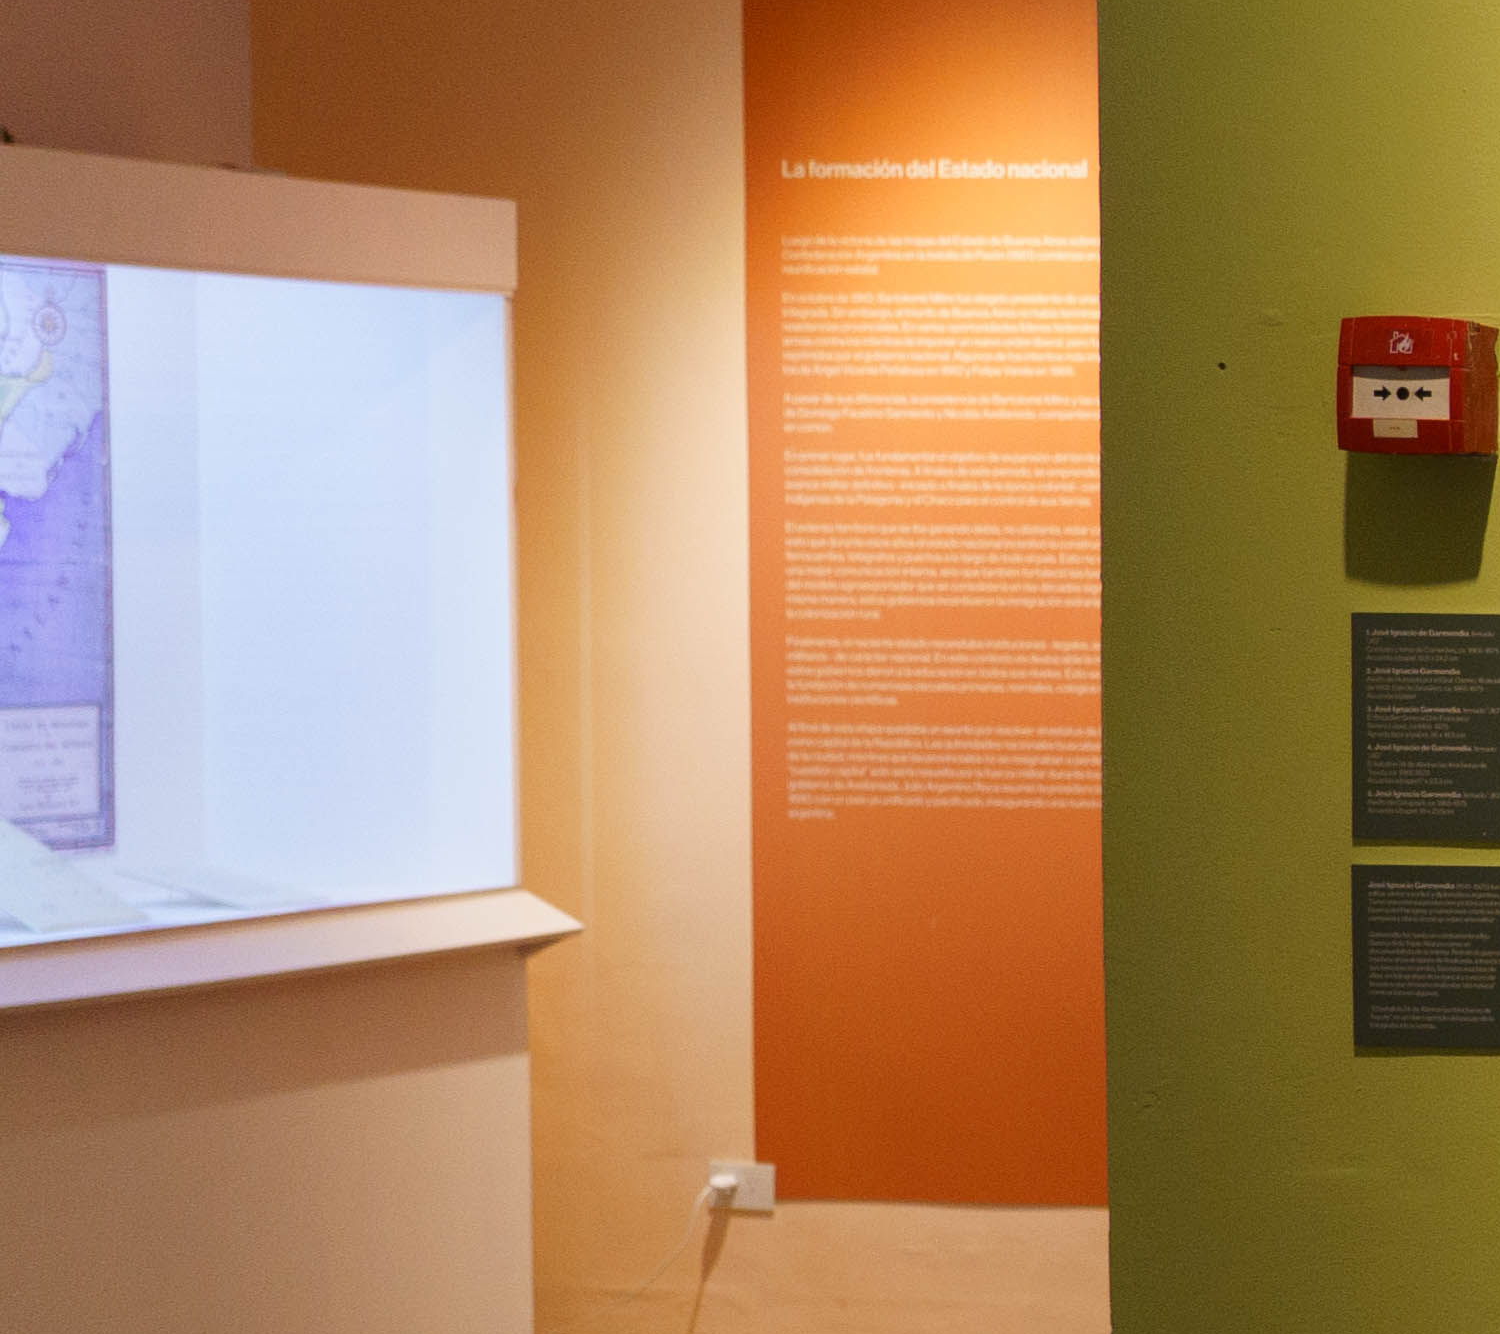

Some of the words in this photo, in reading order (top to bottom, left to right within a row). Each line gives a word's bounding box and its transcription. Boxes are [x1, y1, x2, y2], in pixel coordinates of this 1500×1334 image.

[780, 158, 807, 179] La
[807, 158, 904, 179] formación
[905, 158, 936, 179] del
[938, 157, 1006, 179] Estado
[1006, 158, 1089, 179] nacional
